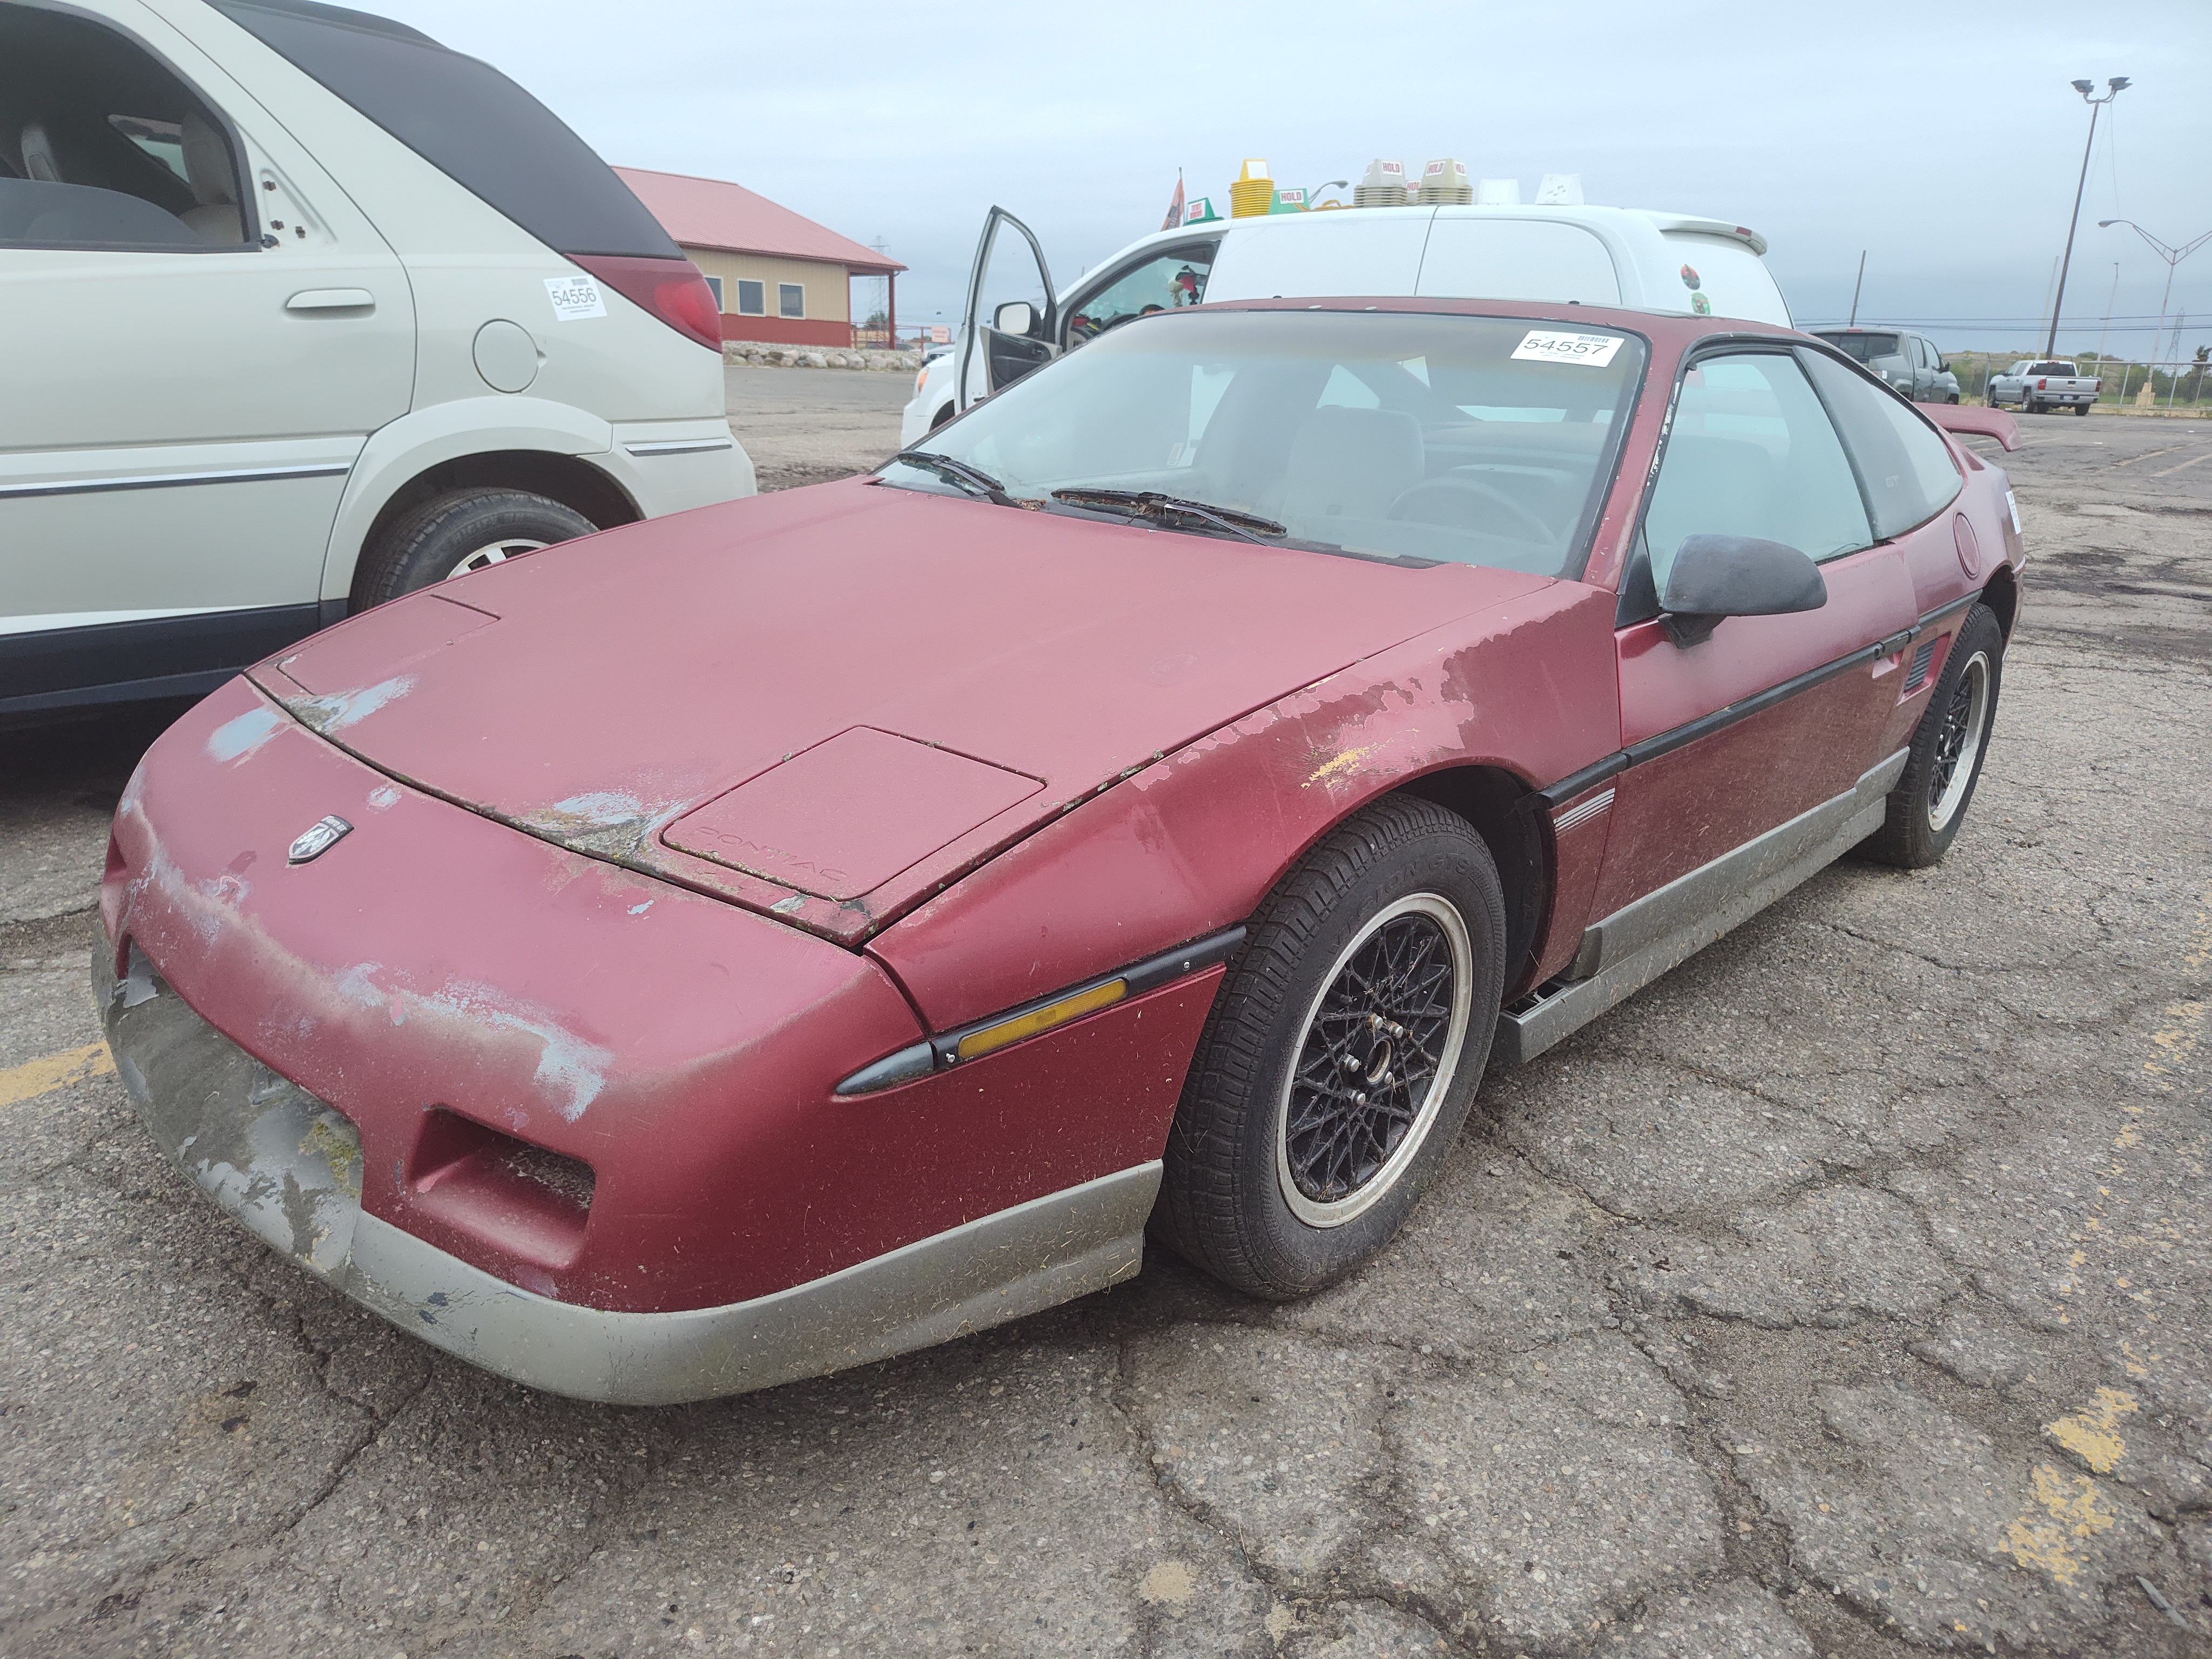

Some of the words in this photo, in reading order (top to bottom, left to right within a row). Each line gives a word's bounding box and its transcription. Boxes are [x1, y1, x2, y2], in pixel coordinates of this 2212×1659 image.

[1382, 163, 1400, 173] HOLD
[1427, 163, 1444, 174] HOLD
[1407, 182, 1419, 191] HOL
[1280, 192, 1302, 201] HOLD
[552, 287, 597, 306] 54556
[1523, 339, 1608, 355] 54557
